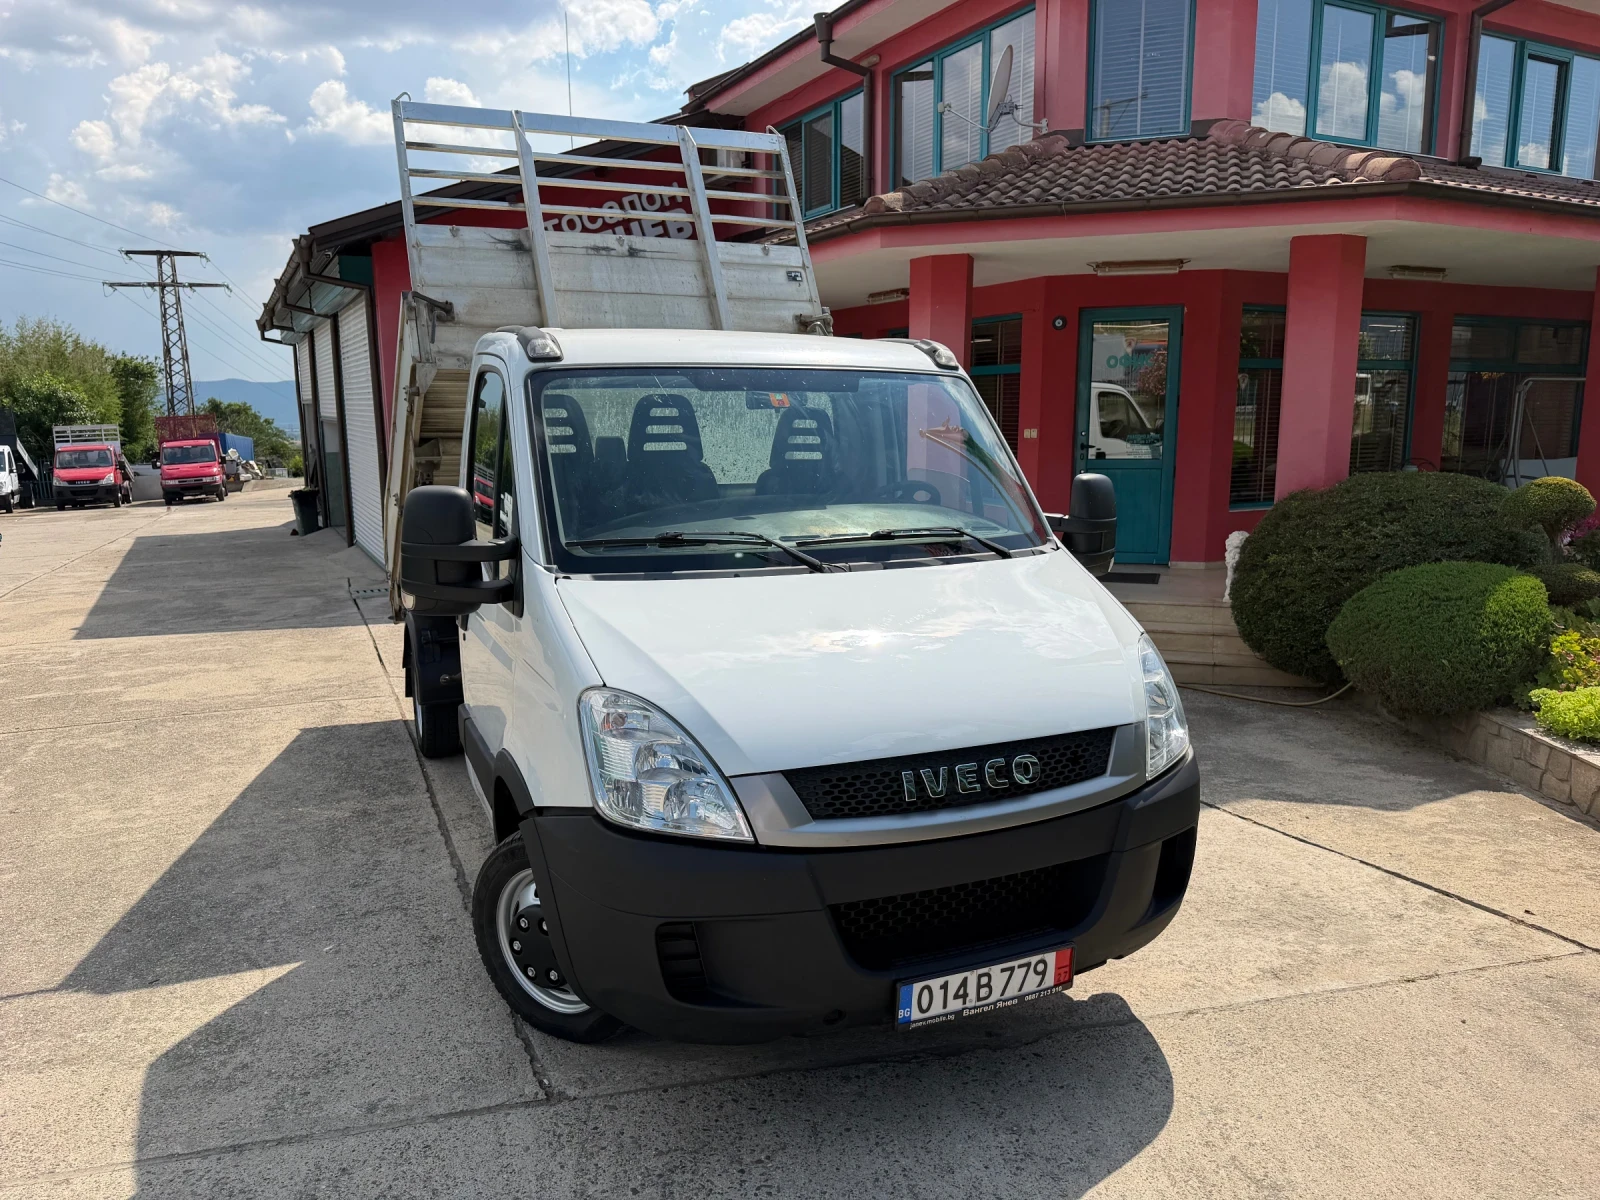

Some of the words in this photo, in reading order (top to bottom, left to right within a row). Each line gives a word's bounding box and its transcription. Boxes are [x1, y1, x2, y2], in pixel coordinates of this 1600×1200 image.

[902, 754, 1041, 801] IVECO
[917, 958, 1048, 1014] 014B779
[1040, 989, 1051, 998] 213
[898, 1008, 910, 1019] BG
[962, 1003, 994, 1017] Вангел
[996, 998, 1018, 1009] Янев
